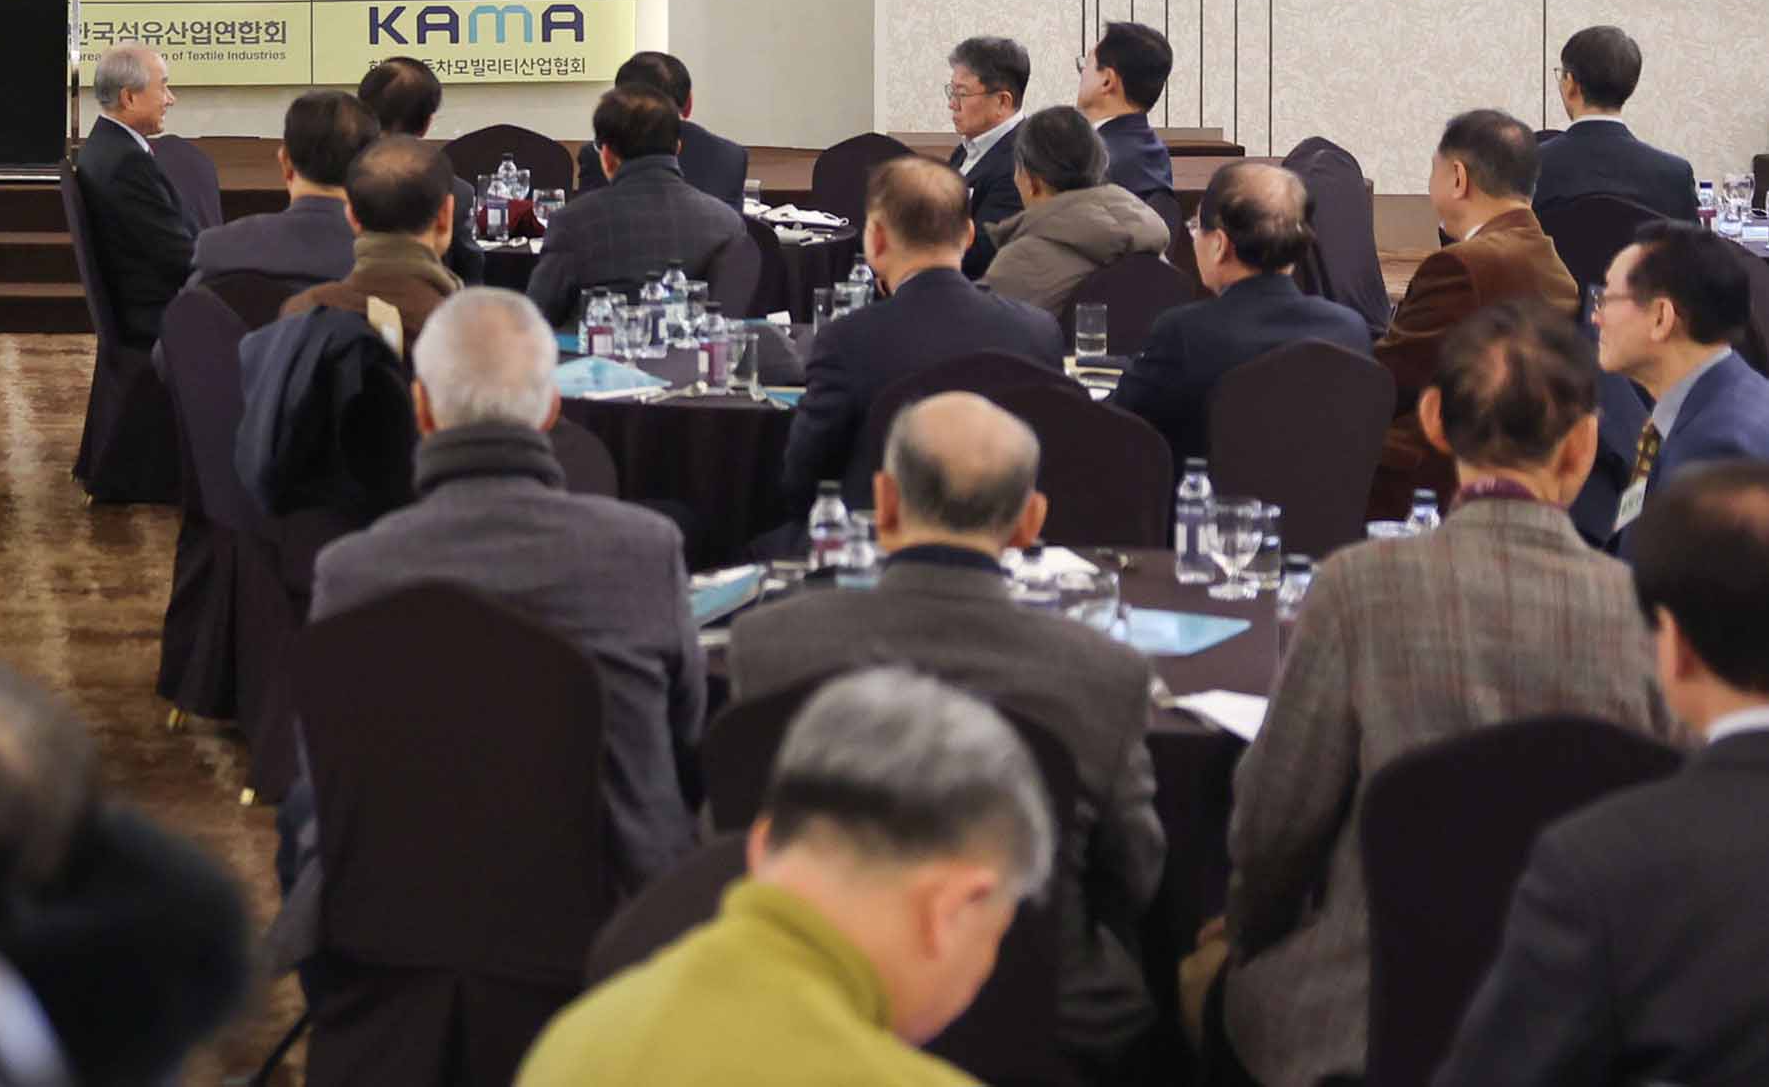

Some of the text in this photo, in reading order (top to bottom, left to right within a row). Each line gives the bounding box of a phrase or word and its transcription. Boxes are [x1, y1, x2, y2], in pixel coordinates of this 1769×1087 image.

[172, 51, 183, 61] of
[187, 51, 224, 61] Textile
[228, 50, 286, 61] Industries
